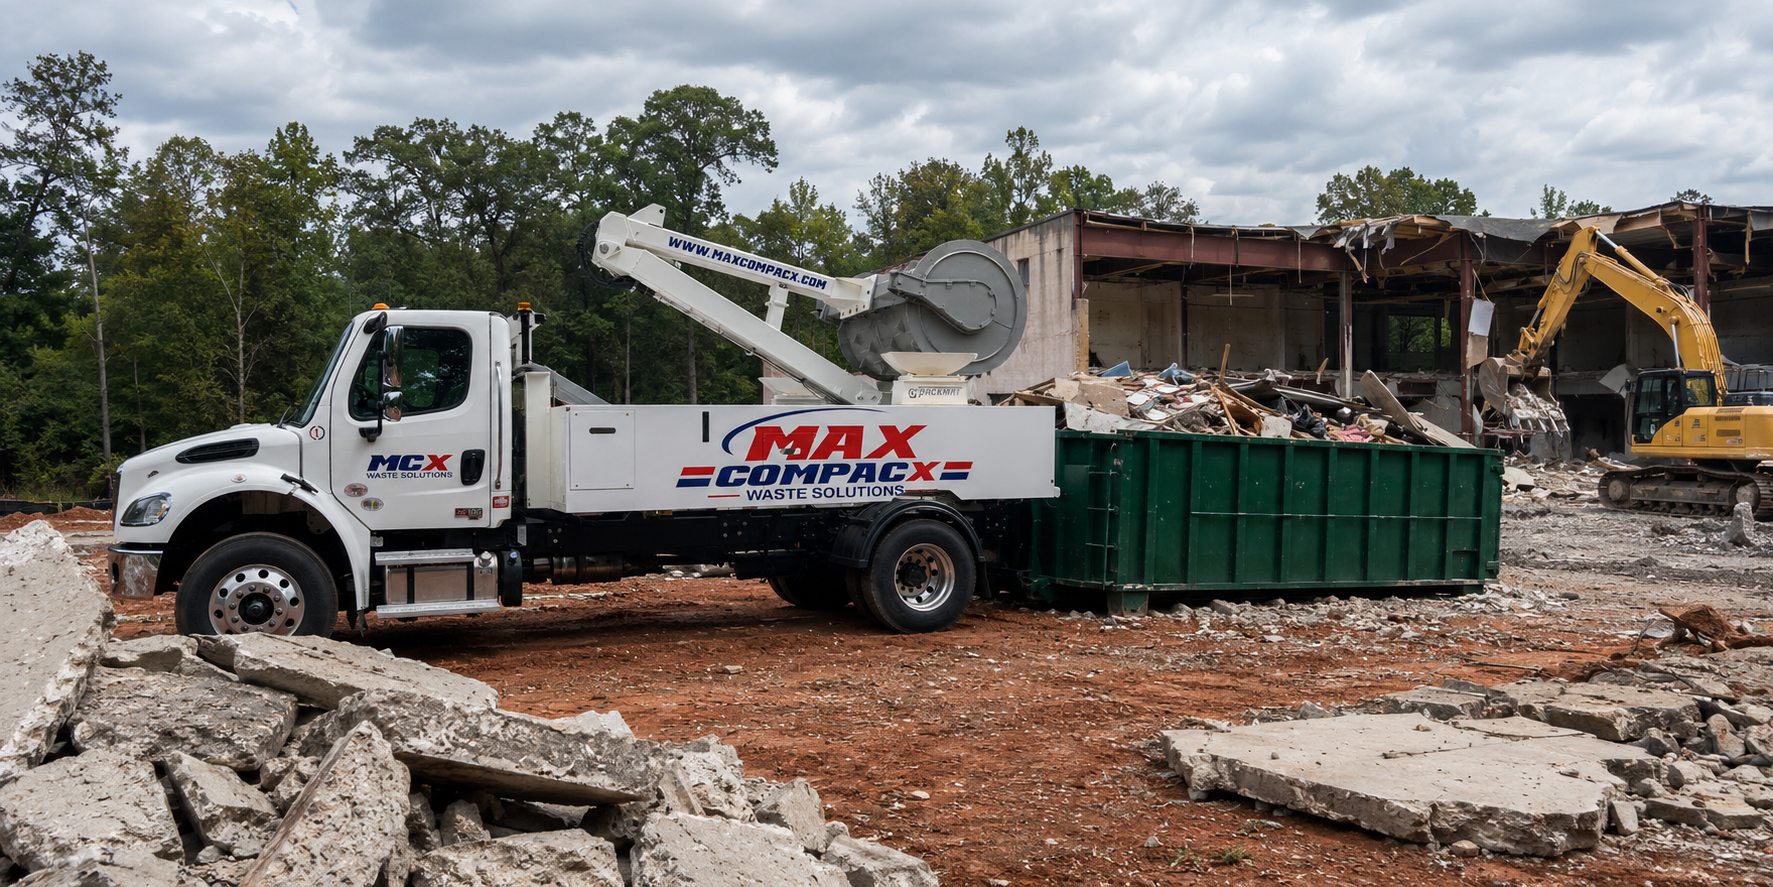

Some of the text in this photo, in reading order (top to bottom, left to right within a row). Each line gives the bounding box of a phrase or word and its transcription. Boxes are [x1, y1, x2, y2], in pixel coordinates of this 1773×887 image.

[668, 236, 828, 290] WWW.MAXCOMPACX.COM
[745, 424, 928, 462] MAX
[367, 454, 453, 471] MCX
[401, 471, 453, 479] SOLUTIONS
[746, 484, 905, 501] WASTE SOLUTIONS
